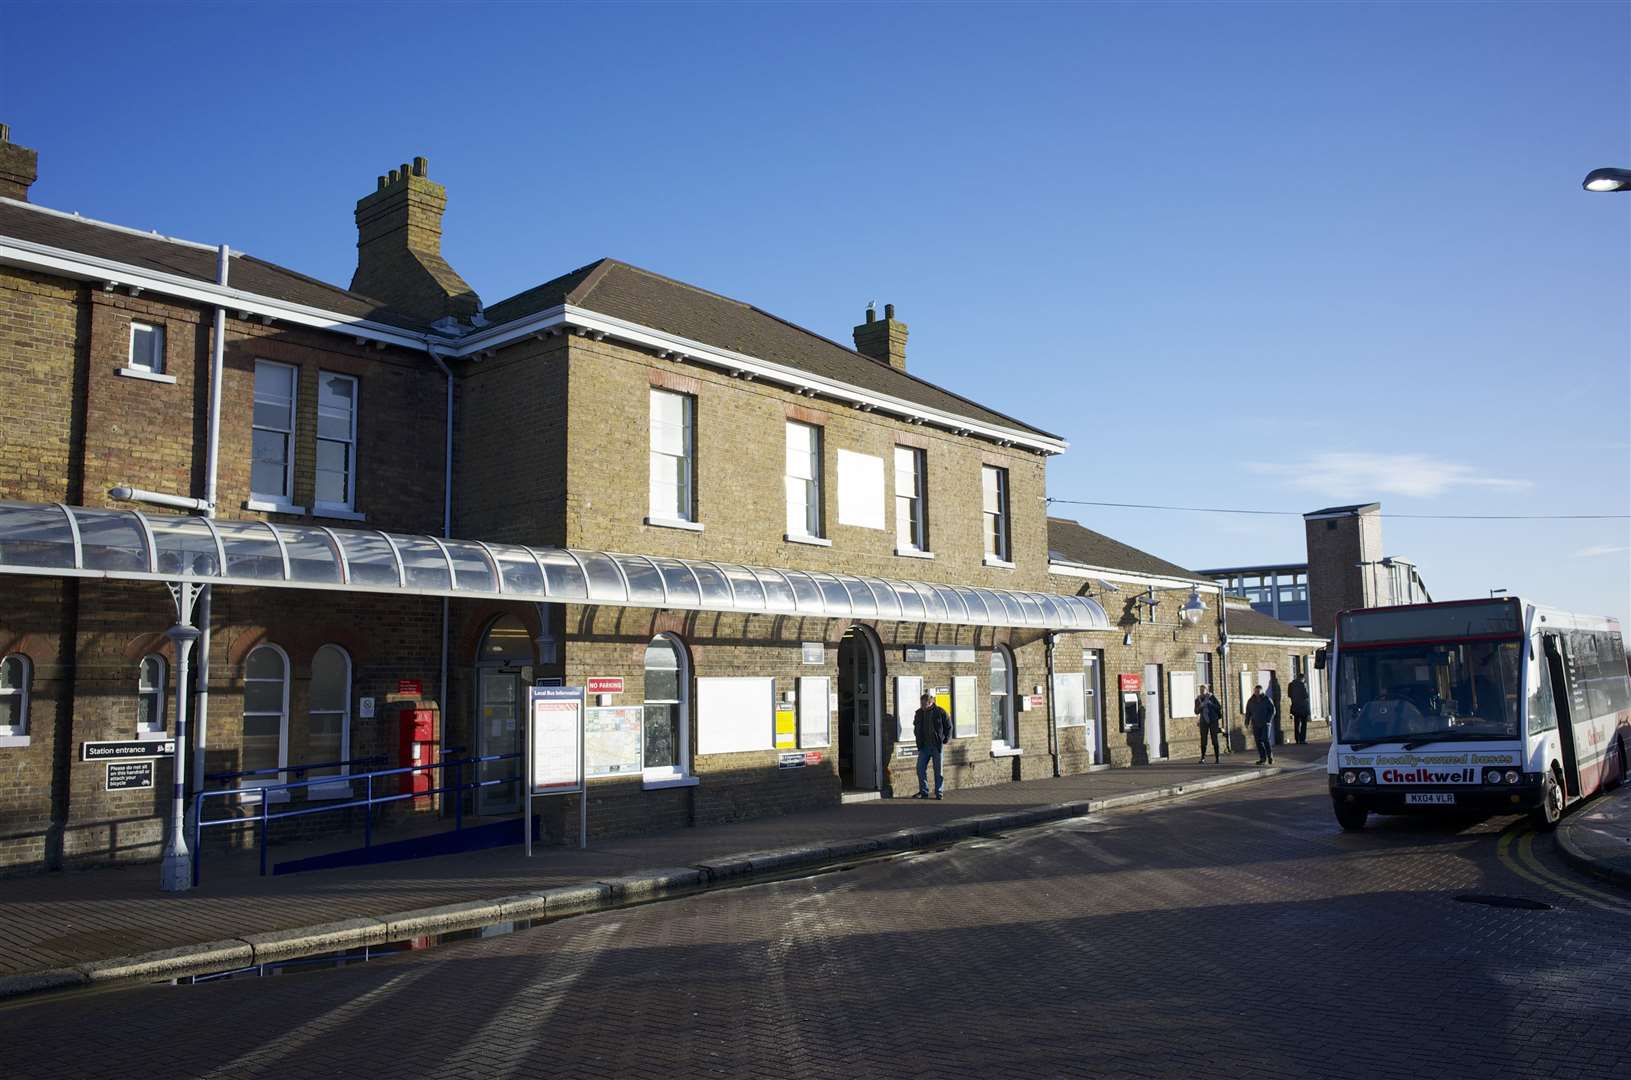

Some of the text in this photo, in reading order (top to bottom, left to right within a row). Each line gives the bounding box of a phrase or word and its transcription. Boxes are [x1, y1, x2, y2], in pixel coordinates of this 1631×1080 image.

[89, 747, 114, 755] Station
[1345, 755, 1373, 765] Your
[1471, 753, 1512, 764] buses
[1382, 768, 1475, 783] Chalkwell
[1435, 794, 1453, 802] VLR
